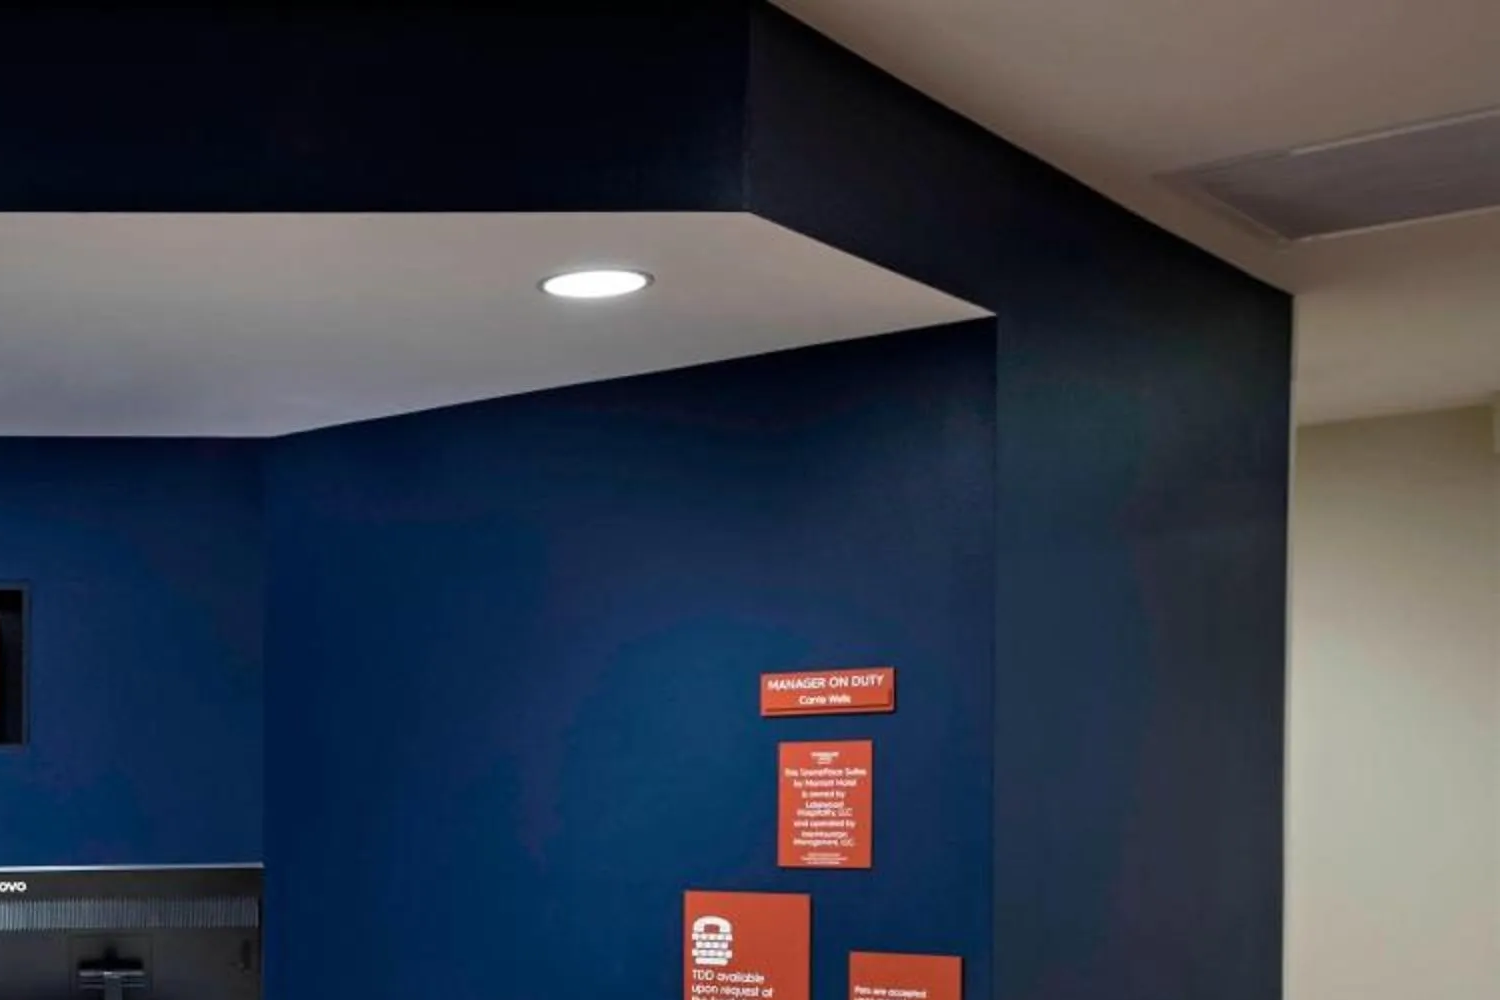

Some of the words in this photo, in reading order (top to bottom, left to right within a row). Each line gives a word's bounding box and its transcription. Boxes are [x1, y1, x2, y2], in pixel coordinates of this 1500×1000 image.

[767, 677, 827, 691] MANAGER
[829, 676, 849, 688] ON
[851, 674, 885, 687] DUTY
[692, 969, 715, 981] TDD
[716, 971, 765, 984] available
[691, 985, 719, 995] upon
[720, 986, 759, 998] request
